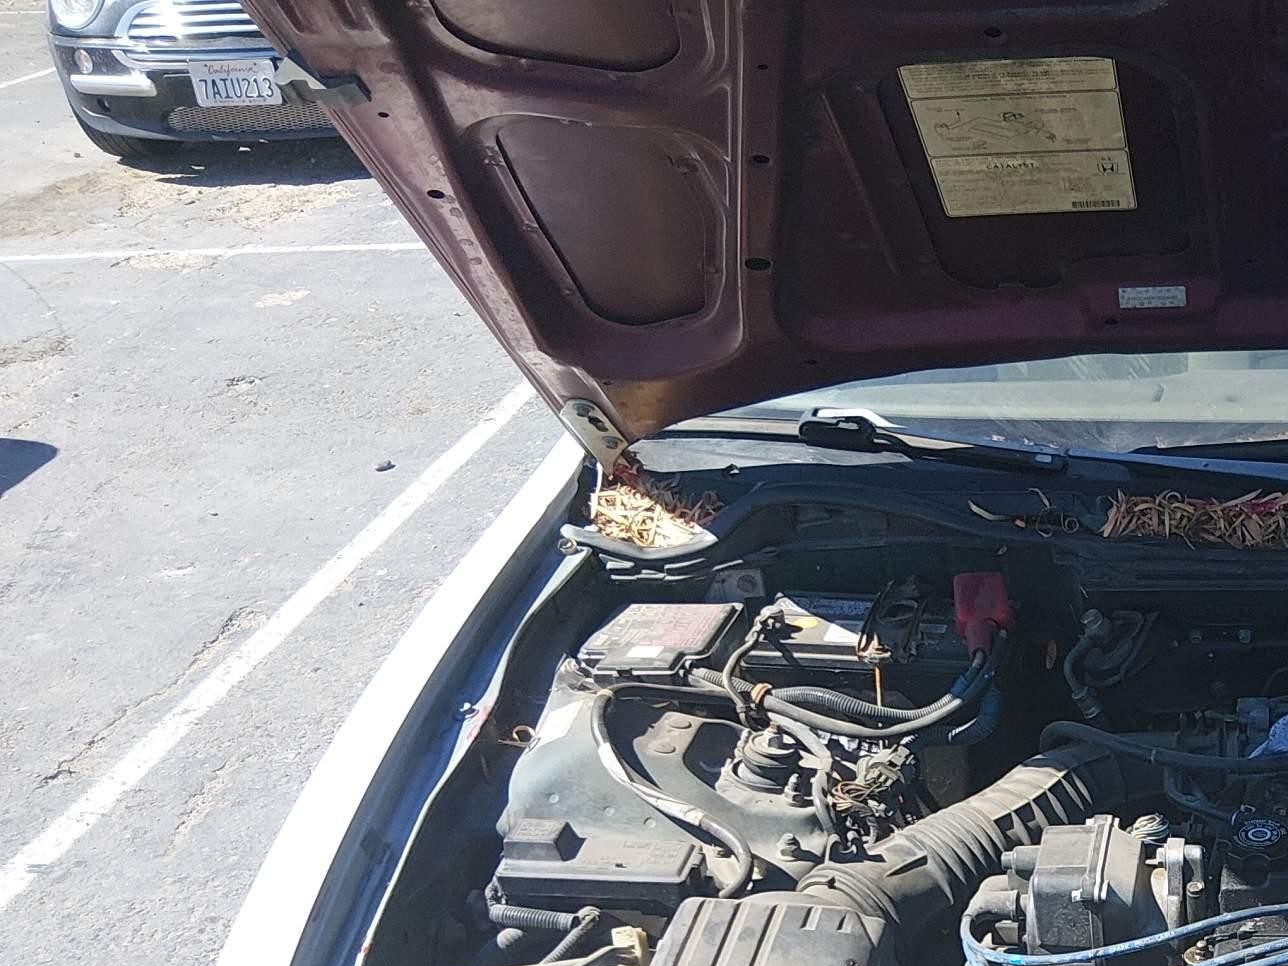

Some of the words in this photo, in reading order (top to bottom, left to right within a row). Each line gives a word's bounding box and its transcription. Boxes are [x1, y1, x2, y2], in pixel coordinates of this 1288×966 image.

[207, 64, 257, 76] California
[198, 77, 274, 99] 7AIU213
[986, 162, 1036, 170] CATALYST
